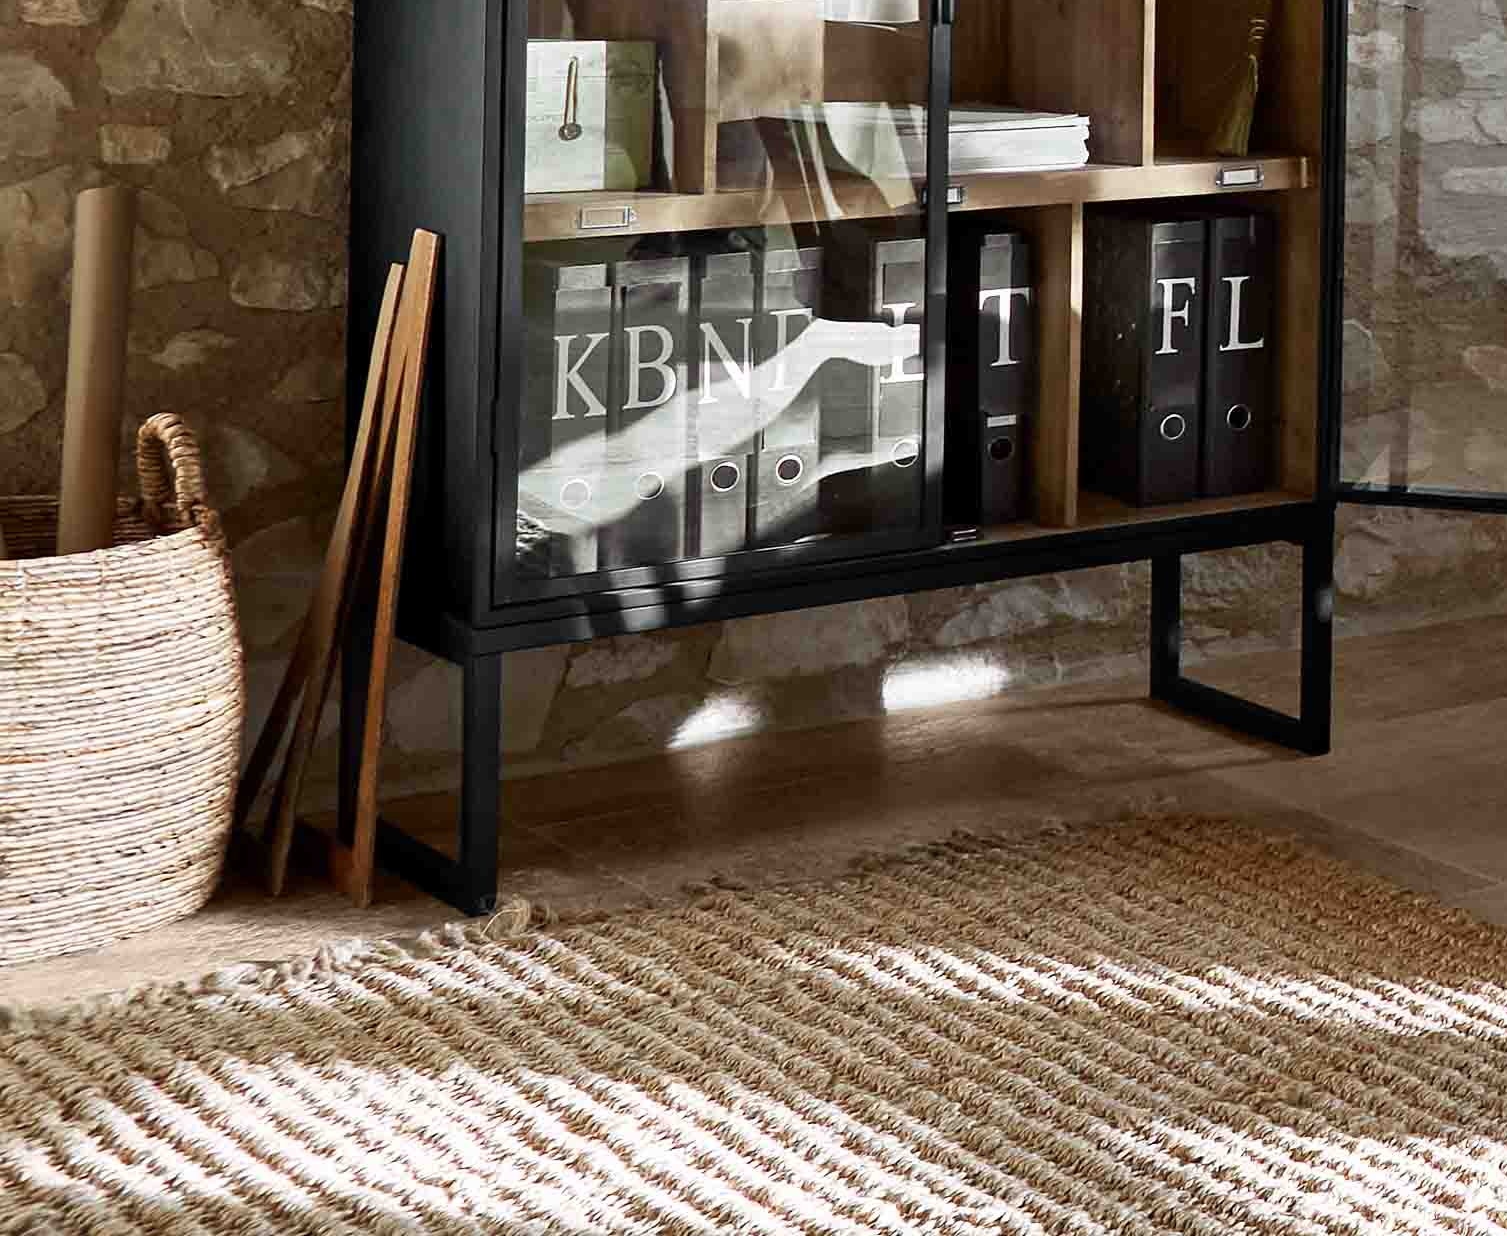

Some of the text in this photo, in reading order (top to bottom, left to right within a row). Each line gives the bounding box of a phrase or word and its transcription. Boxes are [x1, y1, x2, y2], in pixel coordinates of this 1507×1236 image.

[979, 287, 1030, 367] T
[1155, 277, 1196, 355] F
[1219, 275, 1264, 352] L
[552, 332, 610, 420] K
[621, 324, 679, 411] B
[698, 318, 754, 405] N
